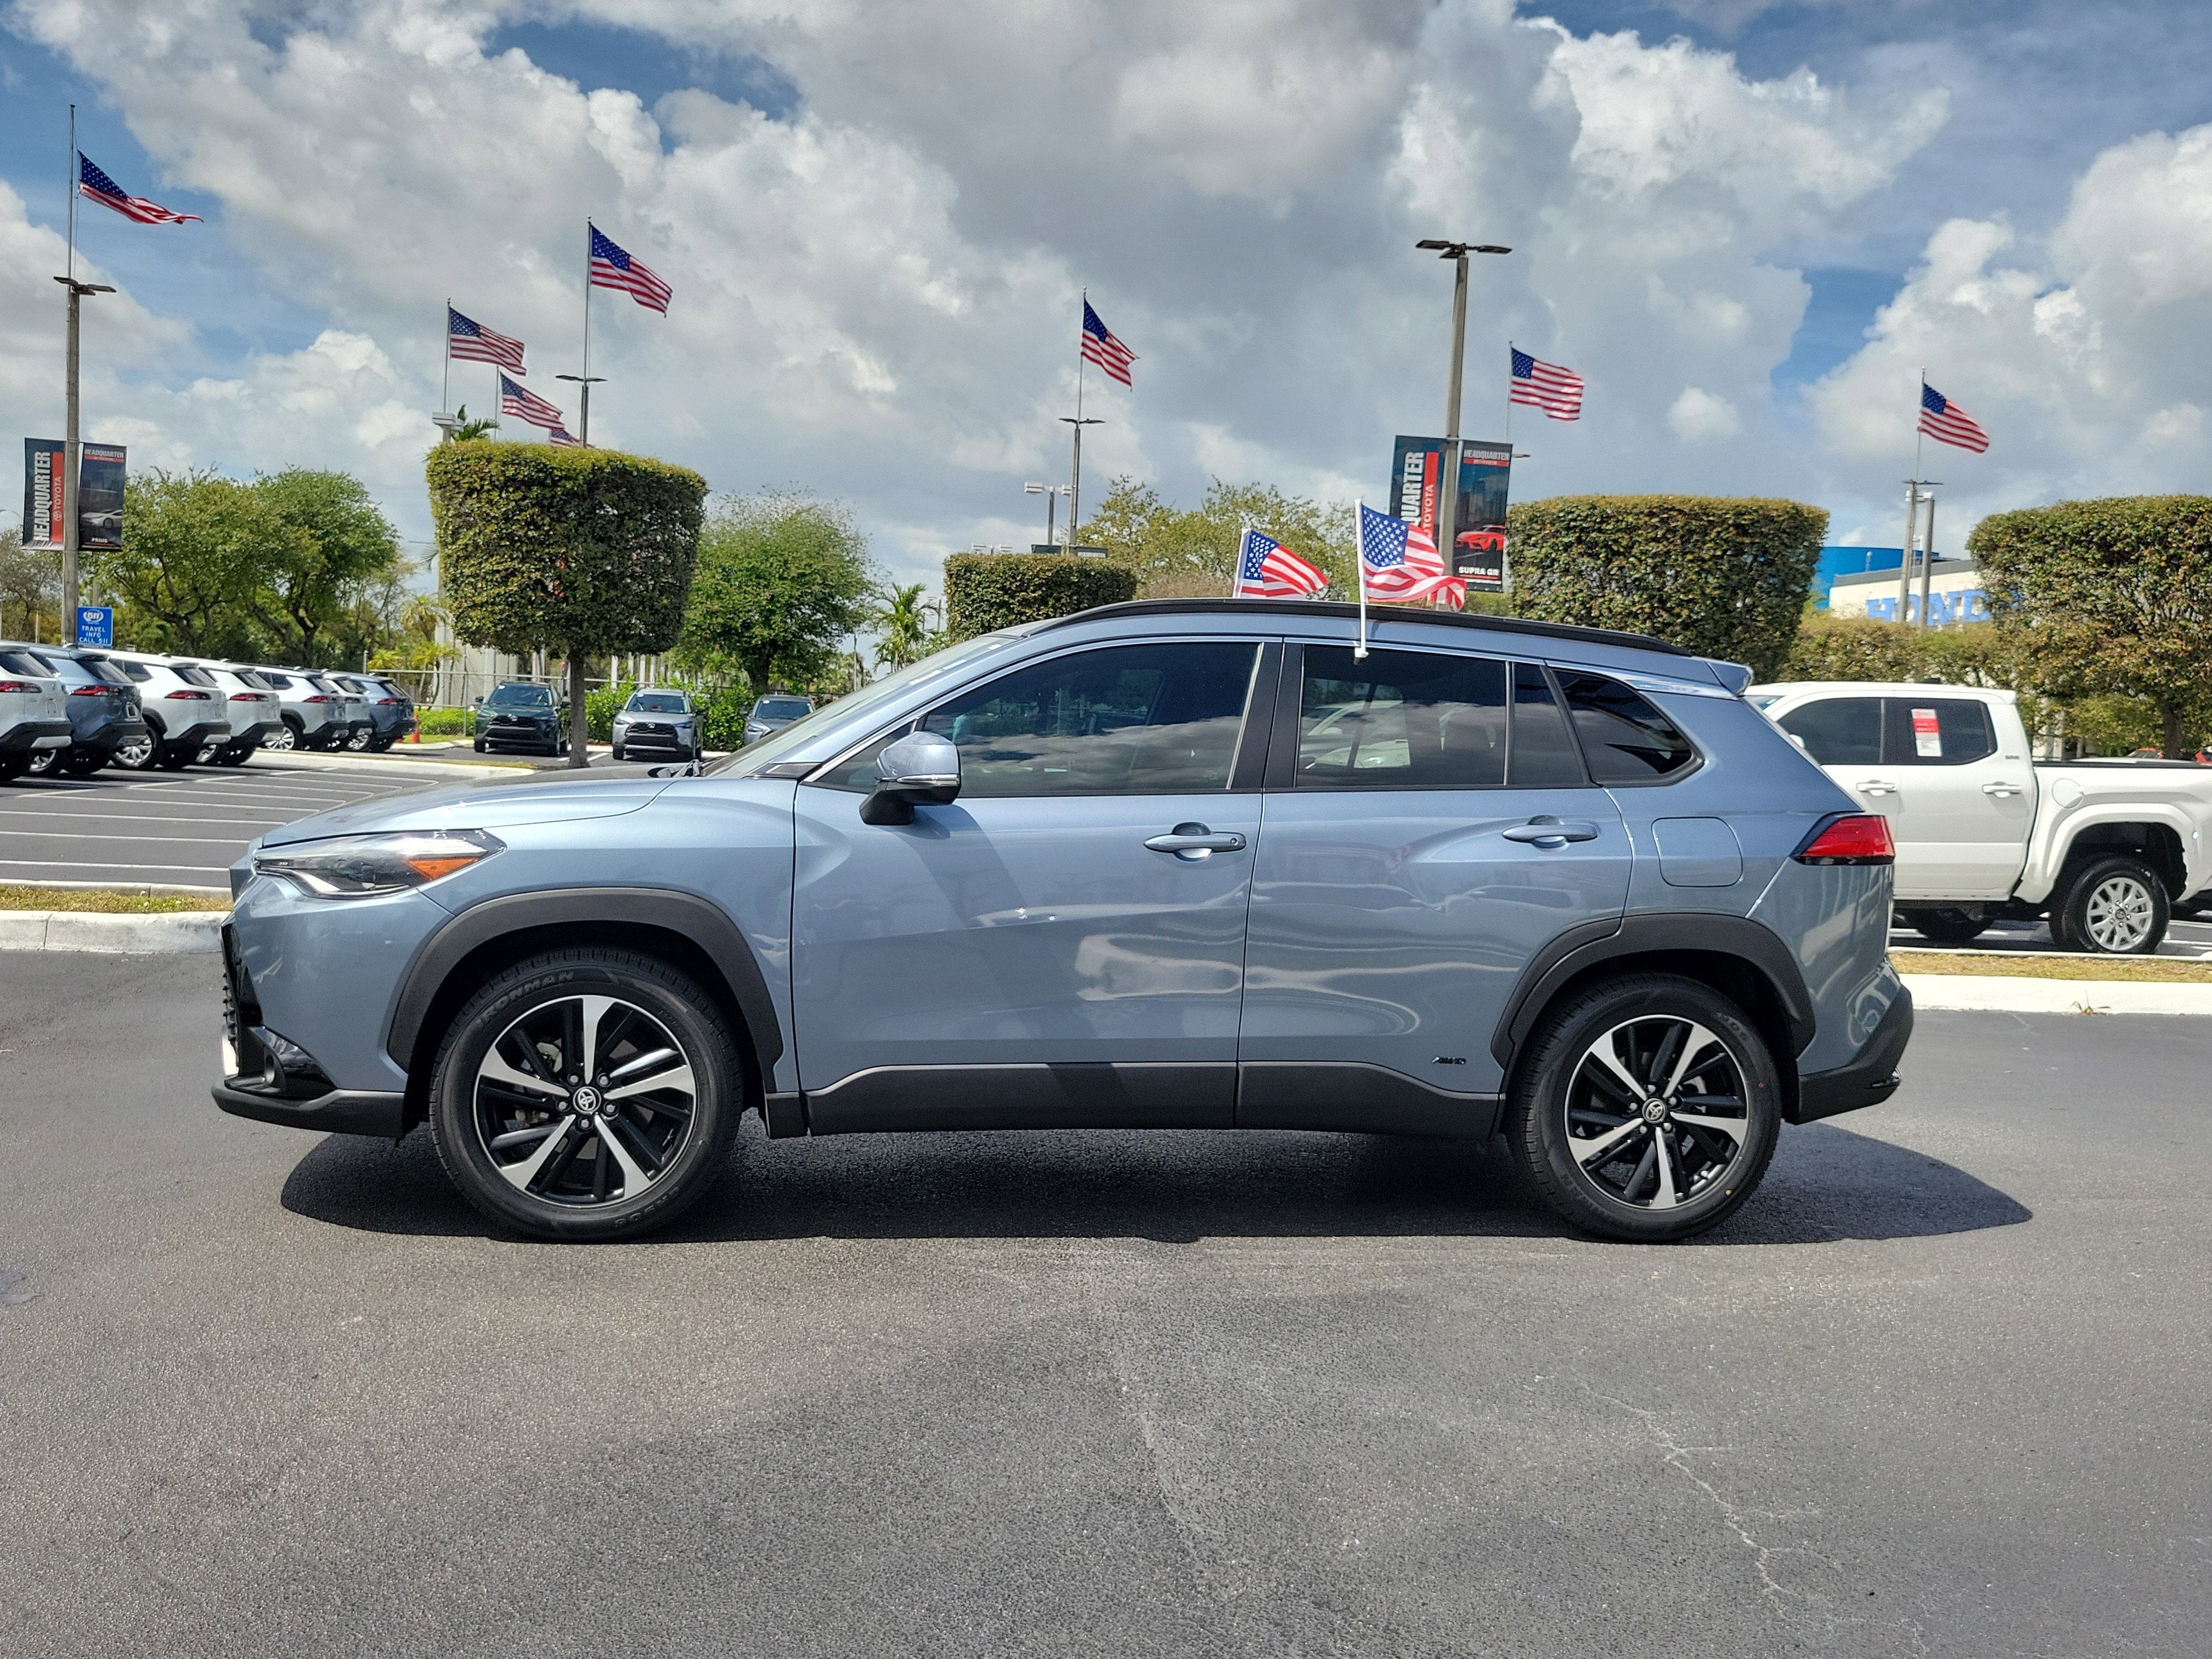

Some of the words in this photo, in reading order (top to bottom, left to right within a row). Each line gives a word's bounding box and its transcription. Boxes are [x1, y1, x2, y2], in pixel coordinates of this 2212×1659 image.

[84, 449, 125, 458] HEADQUARTER
[1464, 449, 1510, 461] HEADQUARTER
[33, 452, 52, 541] HEADQUARTER
[1423, 484, 1435, 530] TOYOTA
[1458, 566, 1486, 575] SUPRA
[475, 971, 574, 1030] IRONMAN
